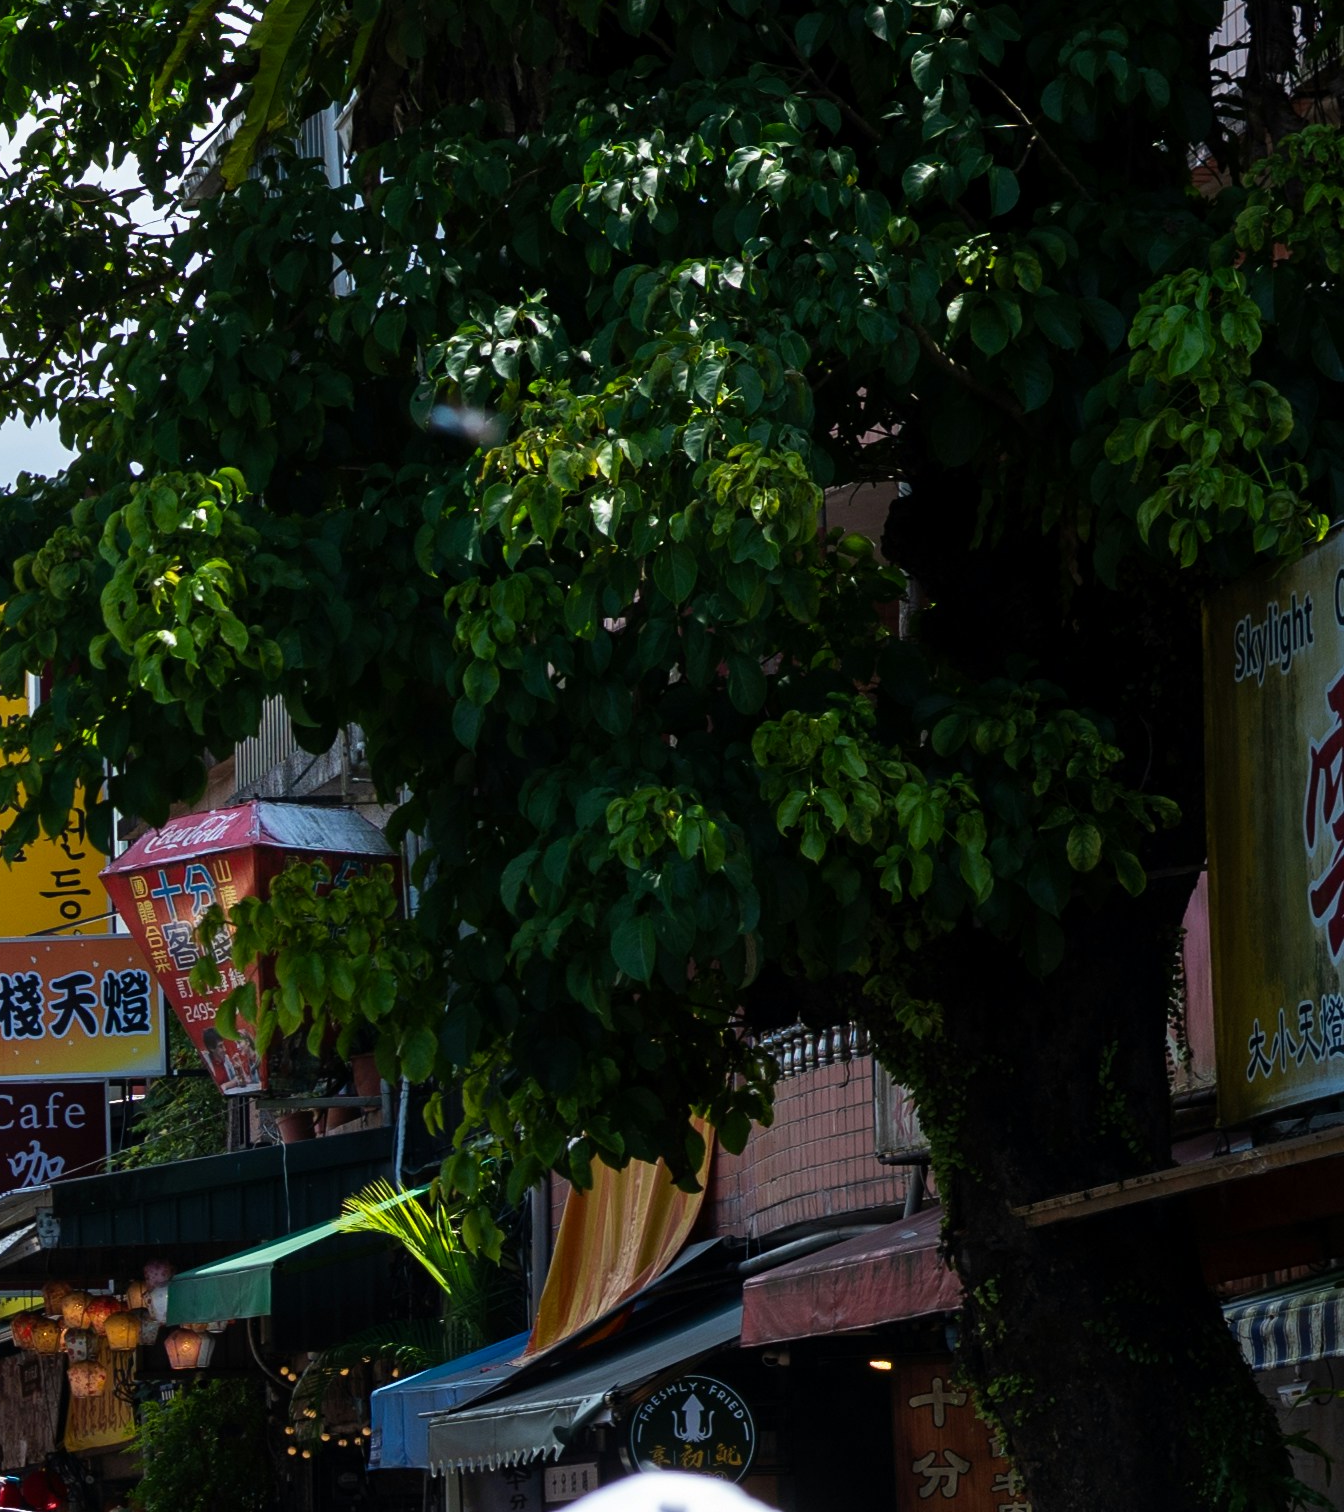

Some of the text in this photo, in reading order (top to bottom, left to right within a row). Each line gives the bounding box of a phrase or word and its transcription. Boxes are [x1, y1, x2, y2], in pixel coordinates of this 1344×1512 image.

[1234, 590, 1313, 687] Skylight
[7, 1140, 65, 1187] 咖
[640, 1381, 744, 1422] FRESHLY FRIED
